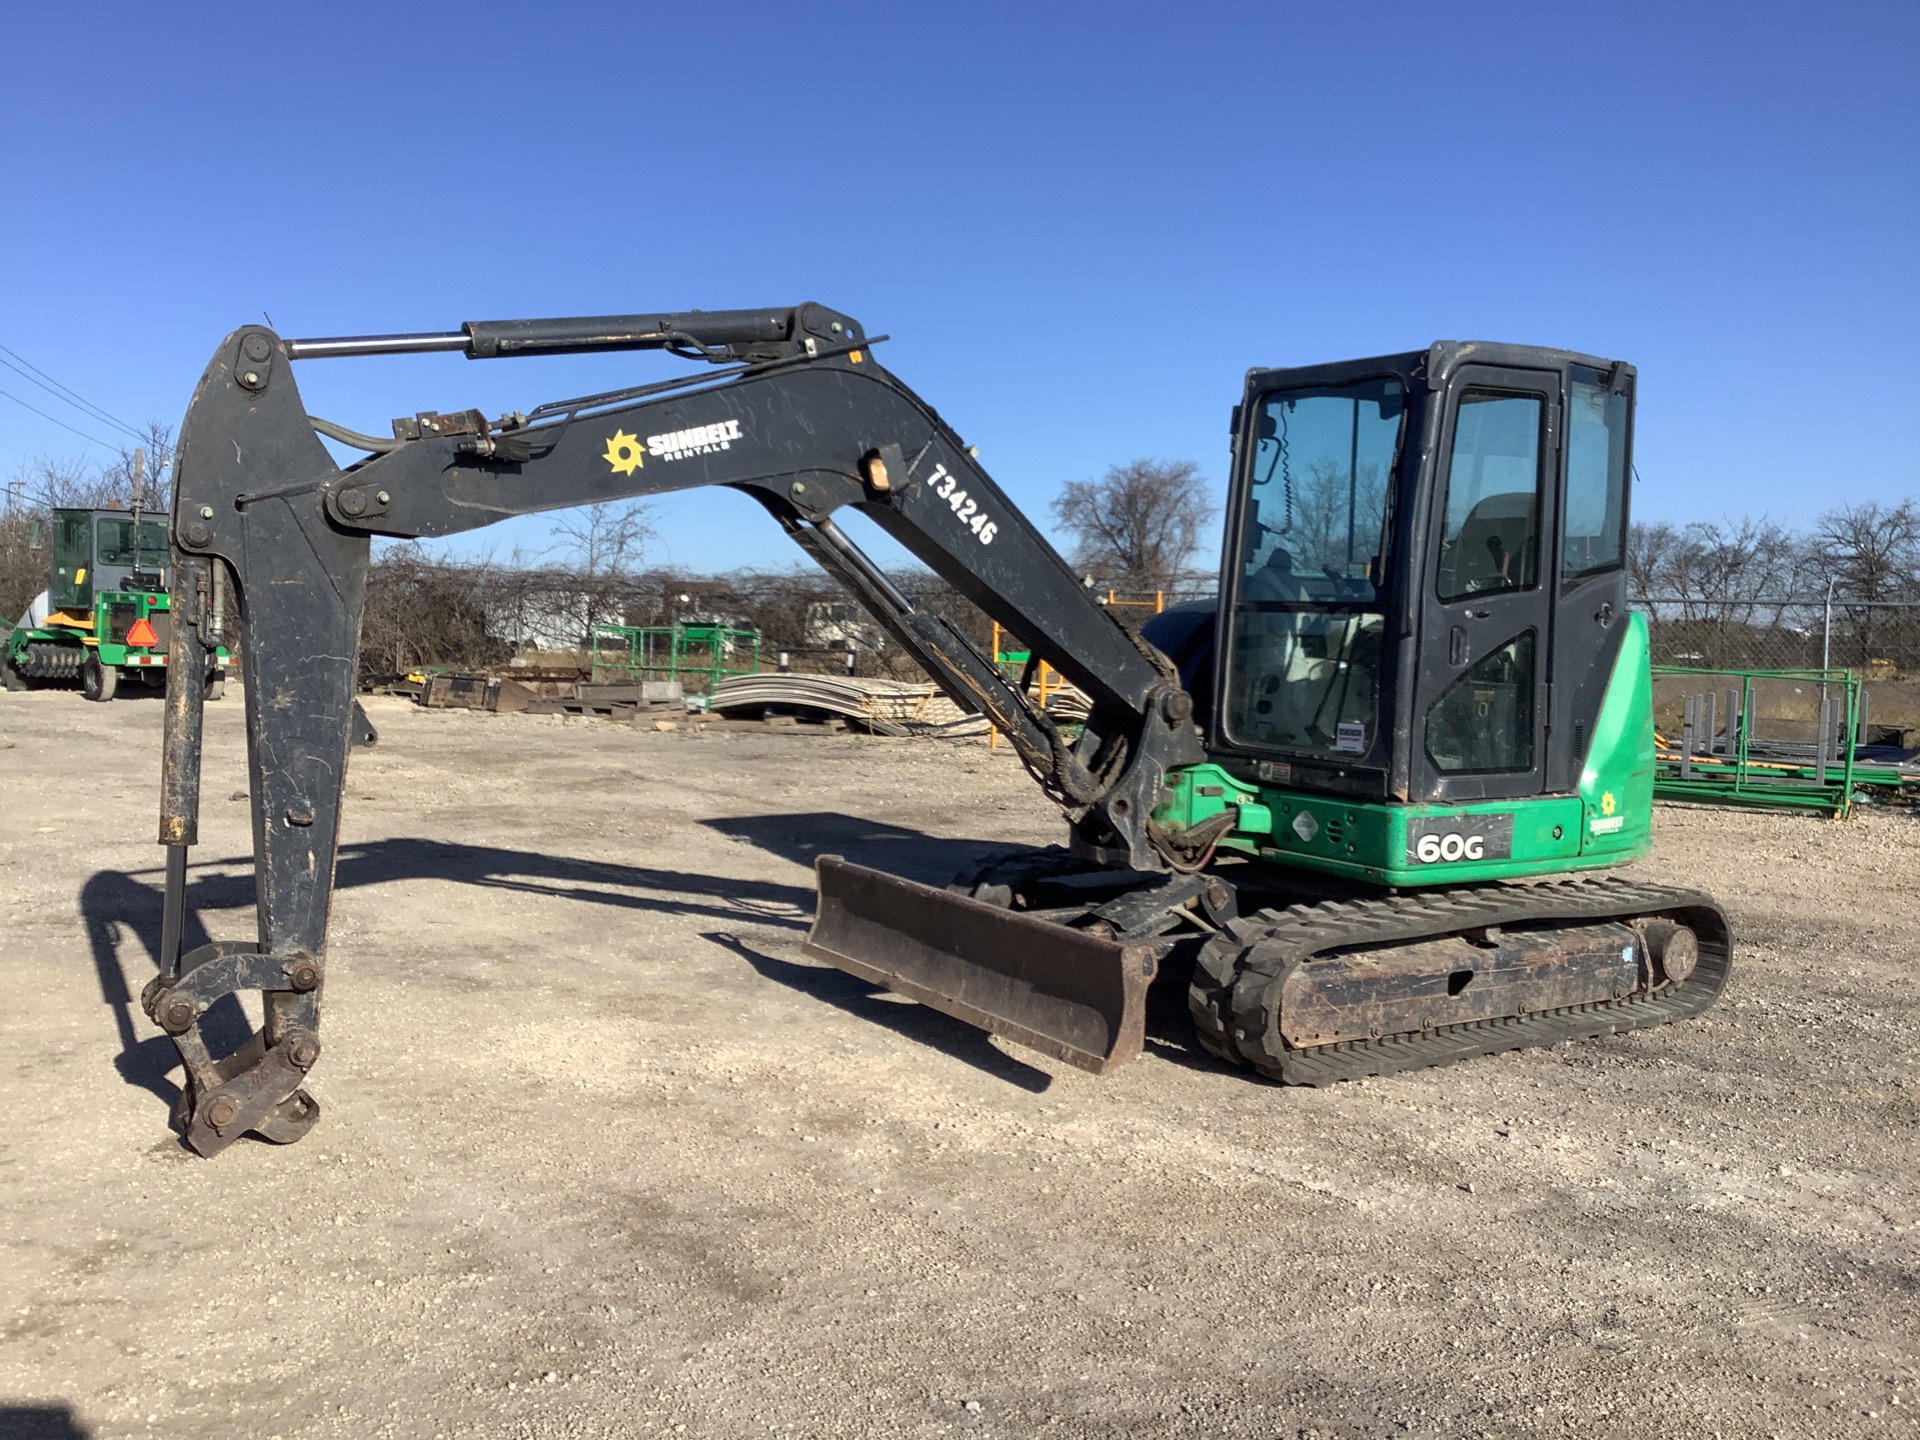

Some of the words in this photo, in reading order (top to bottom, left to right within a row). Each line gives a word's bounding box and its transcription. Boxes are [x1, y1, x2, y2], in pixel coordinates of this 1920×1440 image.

[647, 420, 739, 456] SUNBELT
[664, 441, 730, 462] RENTALS
[927, 463, 998, 545] 734246
[1417, 833, 1484, 863] 60G
